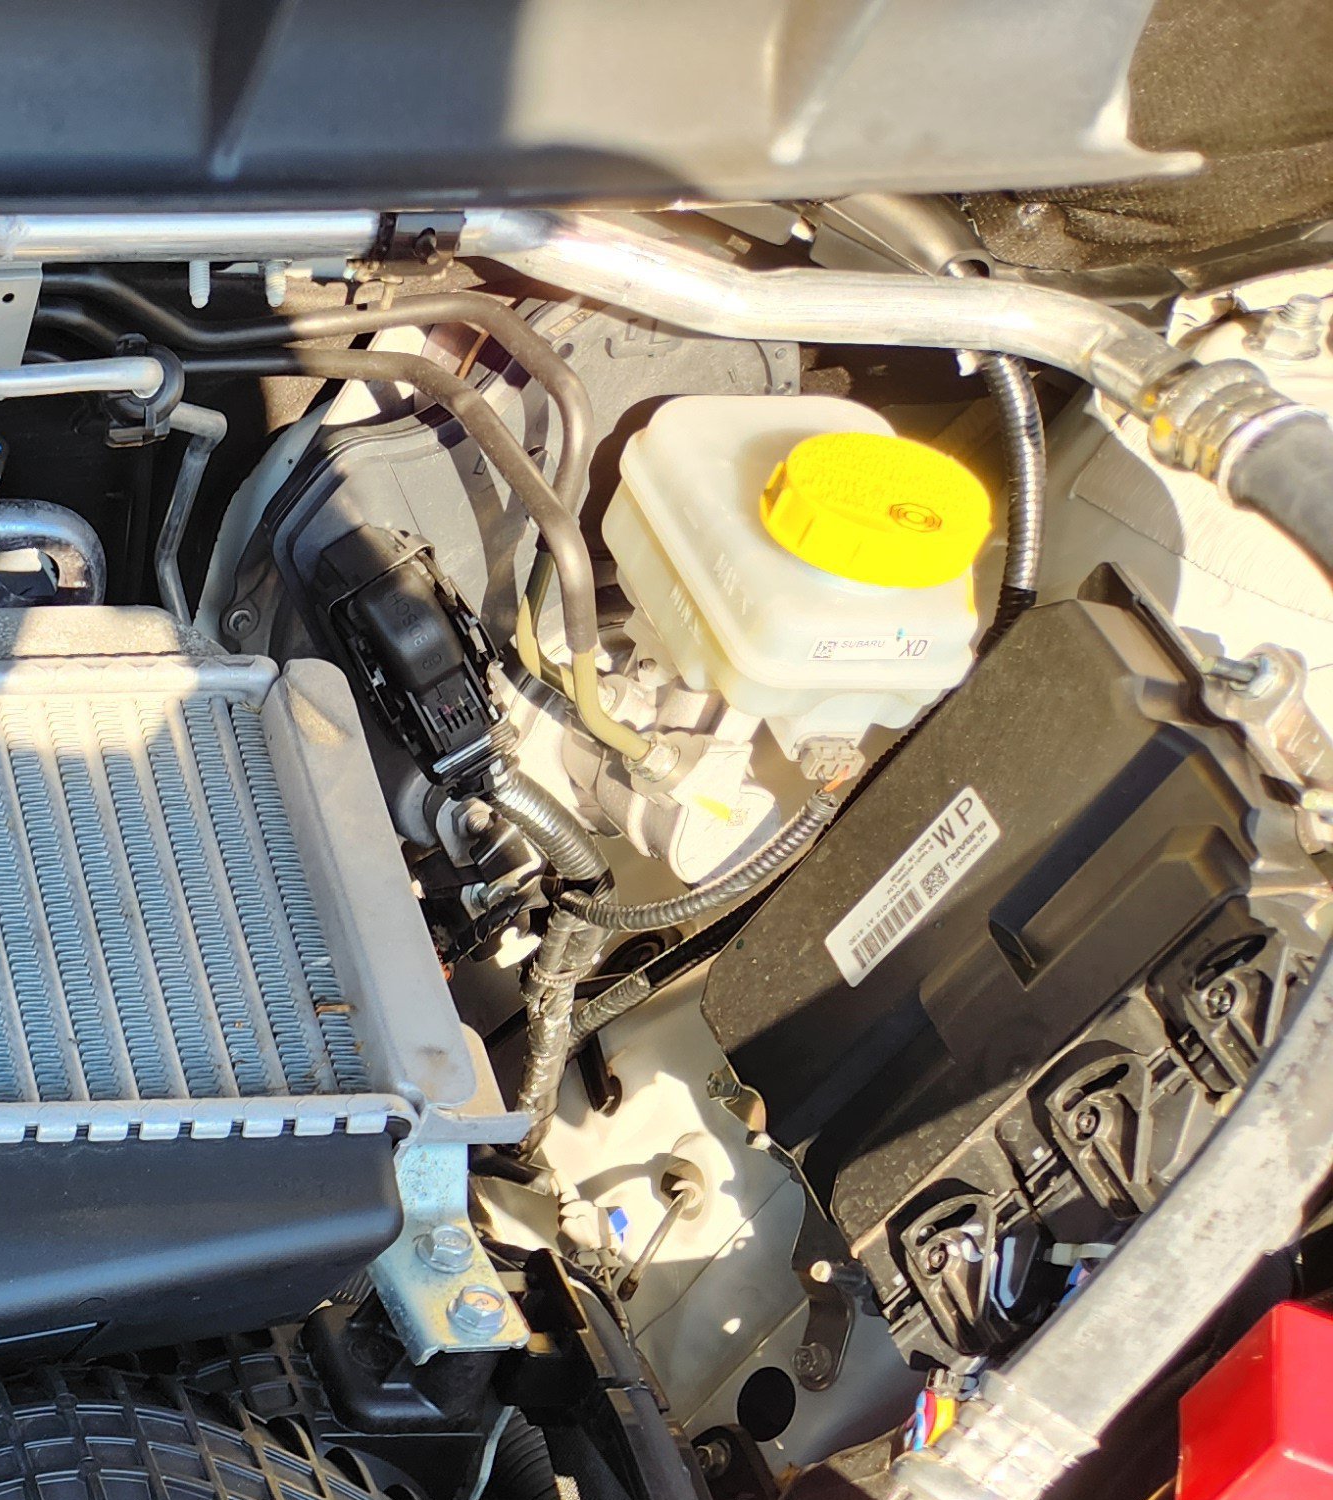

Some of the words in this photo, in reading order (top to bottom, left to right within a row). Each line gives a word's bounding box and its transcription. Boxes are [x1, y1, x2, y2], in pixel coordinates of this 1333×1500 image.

[390, 591, 429, 648] BOSCH
[841, 639, 885, 649] SUBARU
[898, 639, 928, 657] XD
[945, 820, 987, 866] SUBARU
